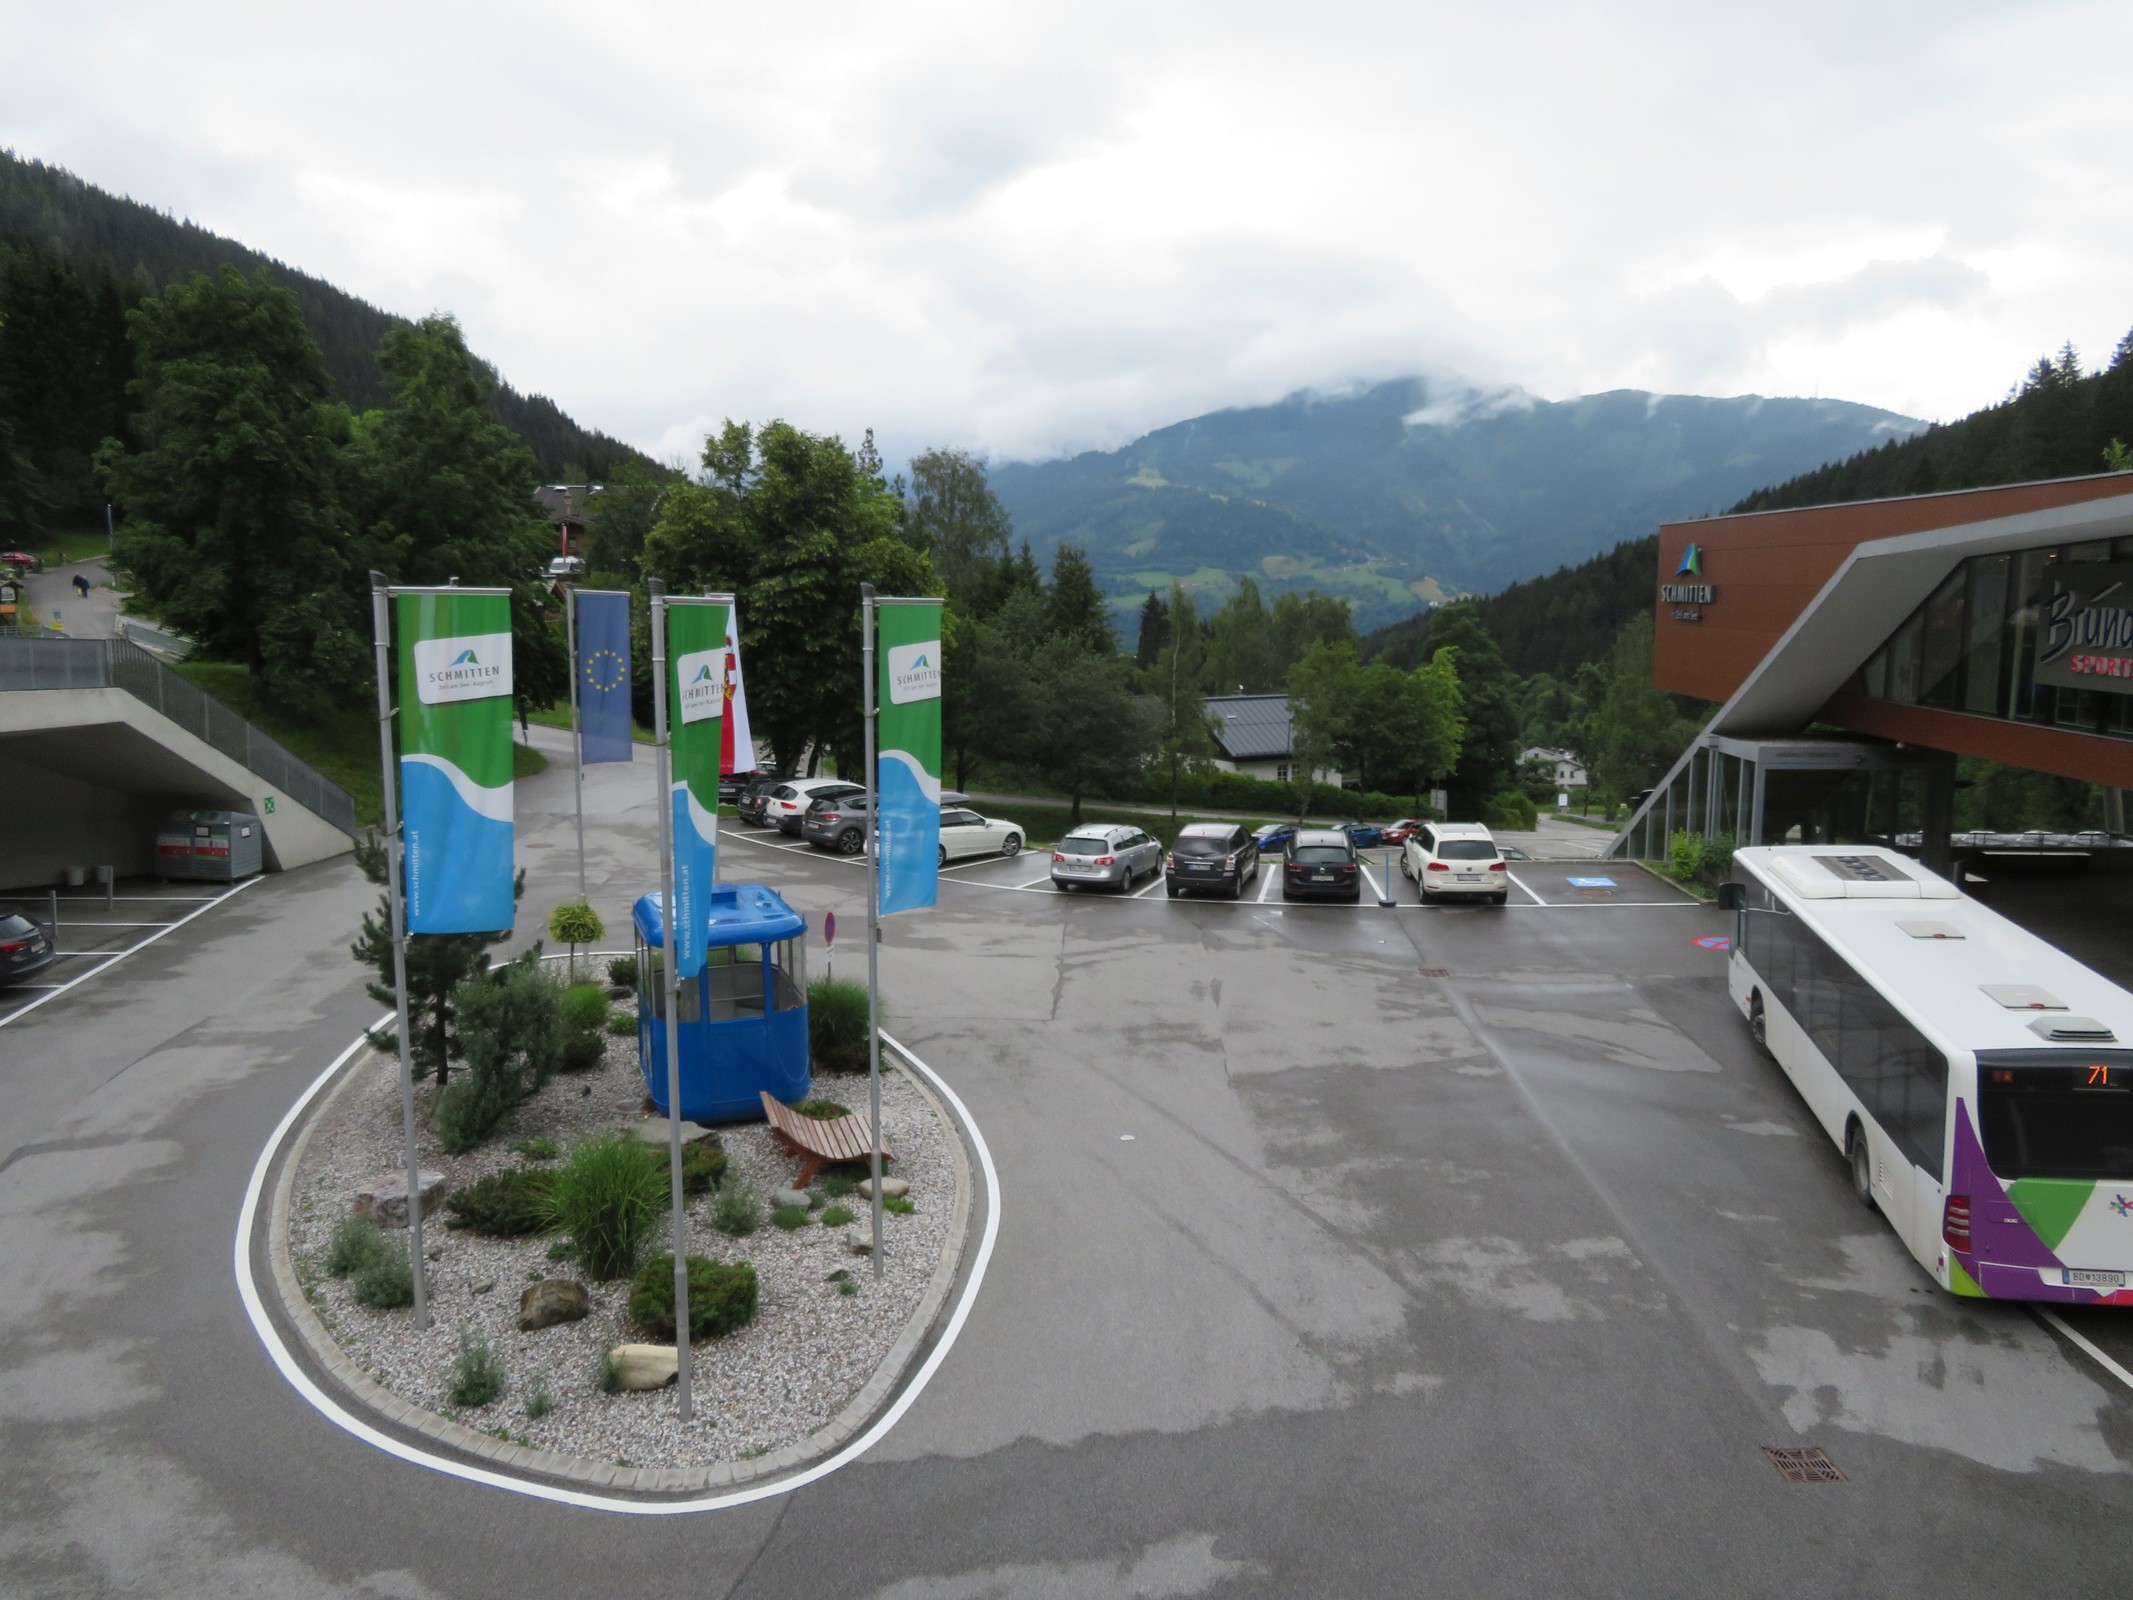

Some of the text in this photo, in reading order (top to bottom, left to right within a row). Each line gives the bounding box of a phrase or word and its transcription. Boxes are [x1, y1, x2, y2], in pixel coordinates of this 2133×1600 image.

[1661, 584, 1713, 604] SCHMITTEN
[429, 666, 500, 683] SCHMITTEN
[411, 831, 420, 917] www.schmitten.at
[681, 865, 691, 960] www.schmitten.at
[2086, 1065, 2108, 1085] 71
[2092, 1273, 2120, 1283] 13890
